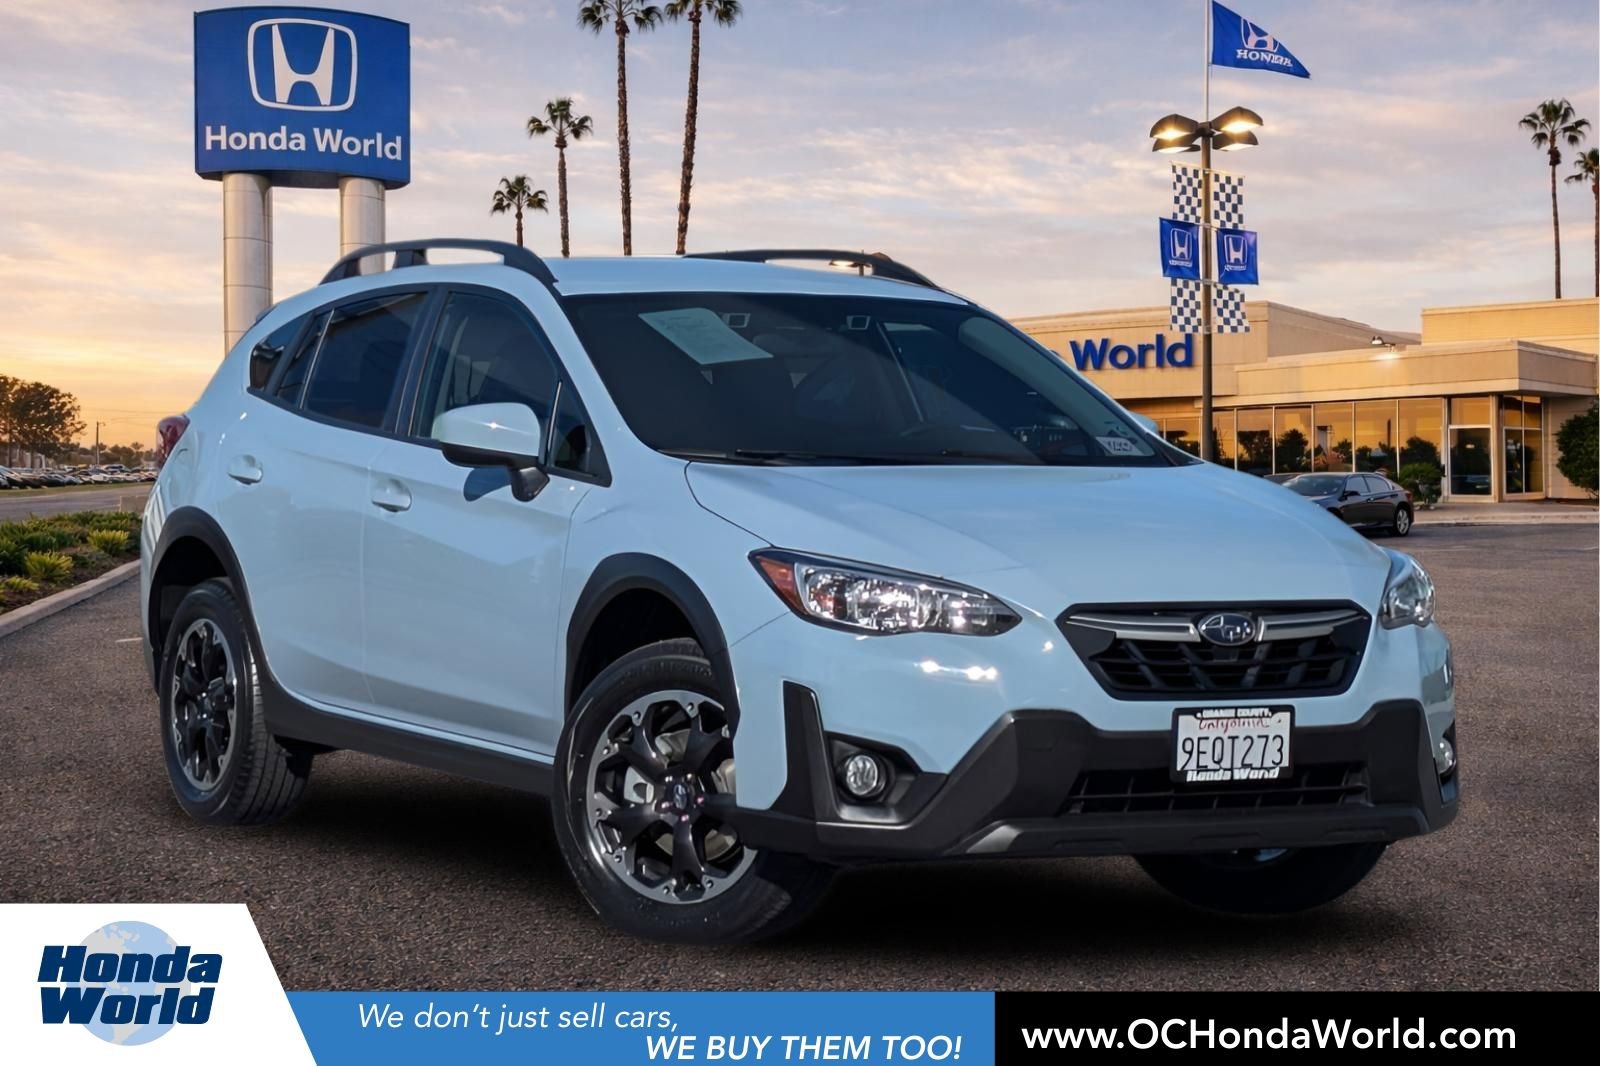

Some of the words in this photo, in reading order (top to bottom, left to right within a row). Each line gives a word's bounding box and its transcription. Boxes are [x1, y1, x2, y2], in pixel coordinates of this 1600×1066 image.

[205, 125, 306, 151] Honda
[313, 127, 402, 160] World
[1069, 333, 1194, 371] World
[1180, 734, 1284, 771] 9EQT273
